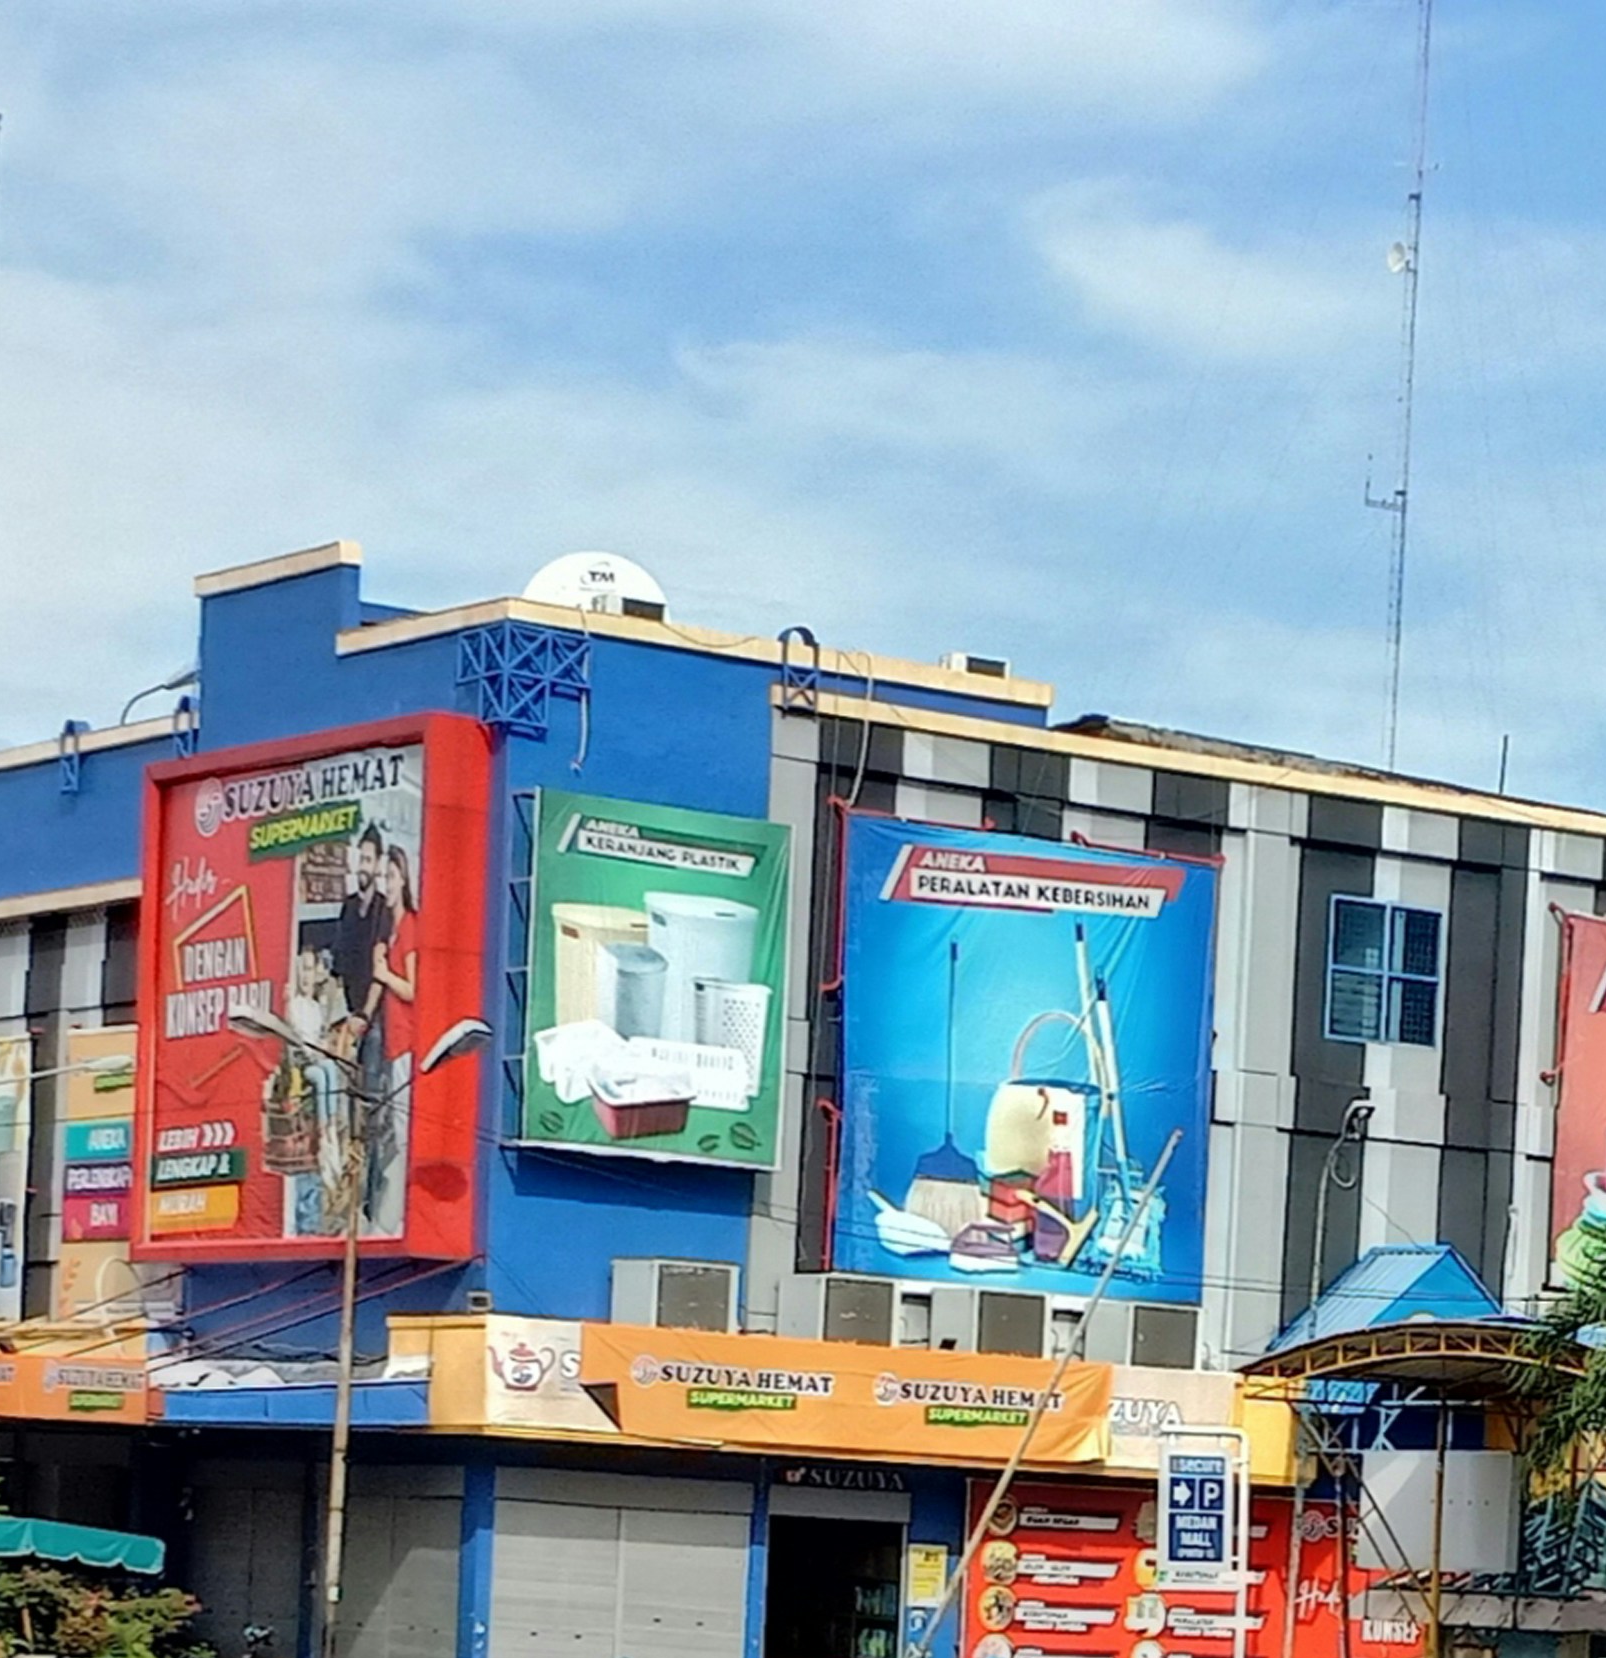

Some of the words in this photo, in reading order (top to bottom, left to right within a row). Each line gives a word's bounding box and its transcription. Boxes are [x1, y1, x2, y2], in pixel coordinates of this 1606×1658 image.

[224, 772, 315, 818] SUZUYA
[321, 755, 404, 799] HEMAT
[249, 807, 358, 849] SUPERMARKET
[586, 819, 640, 838] ANEKA
[586, 836, 677, 861] KERANJANG
[681, 851, 741, 871] PLASTIK
[918, 850, 986, 873] ANEKA
[917, 874, 1031, 900] PERALATAN
[1037, 883, 1151, 911] KEBERSIHAN
[184, 937, 246, 982] DENGAN
[166, 986, 225, 1040] KONSEP
[89, 1127, 126, 1151] ANEKA
[156, 1153, 218, 1181] LENGKAP
[660, 1364, 750, 1388] SUZUYA
[756, 1372, 834, 1394] HEMAT
[689, 1390, 795, 1408] SUPERMARKET
[900, 1381, 986, 1405] SUZUYA
[928, 1407, 1028, 1424] SUPERMARKET
[808, 1468, 904, 1491] SUZUYA
[1204, 1481, 1221, 1507] P
[1175, 1515, 1218, 1530] MEDAN
[1180, 1531, 1212, 1546] MALL
